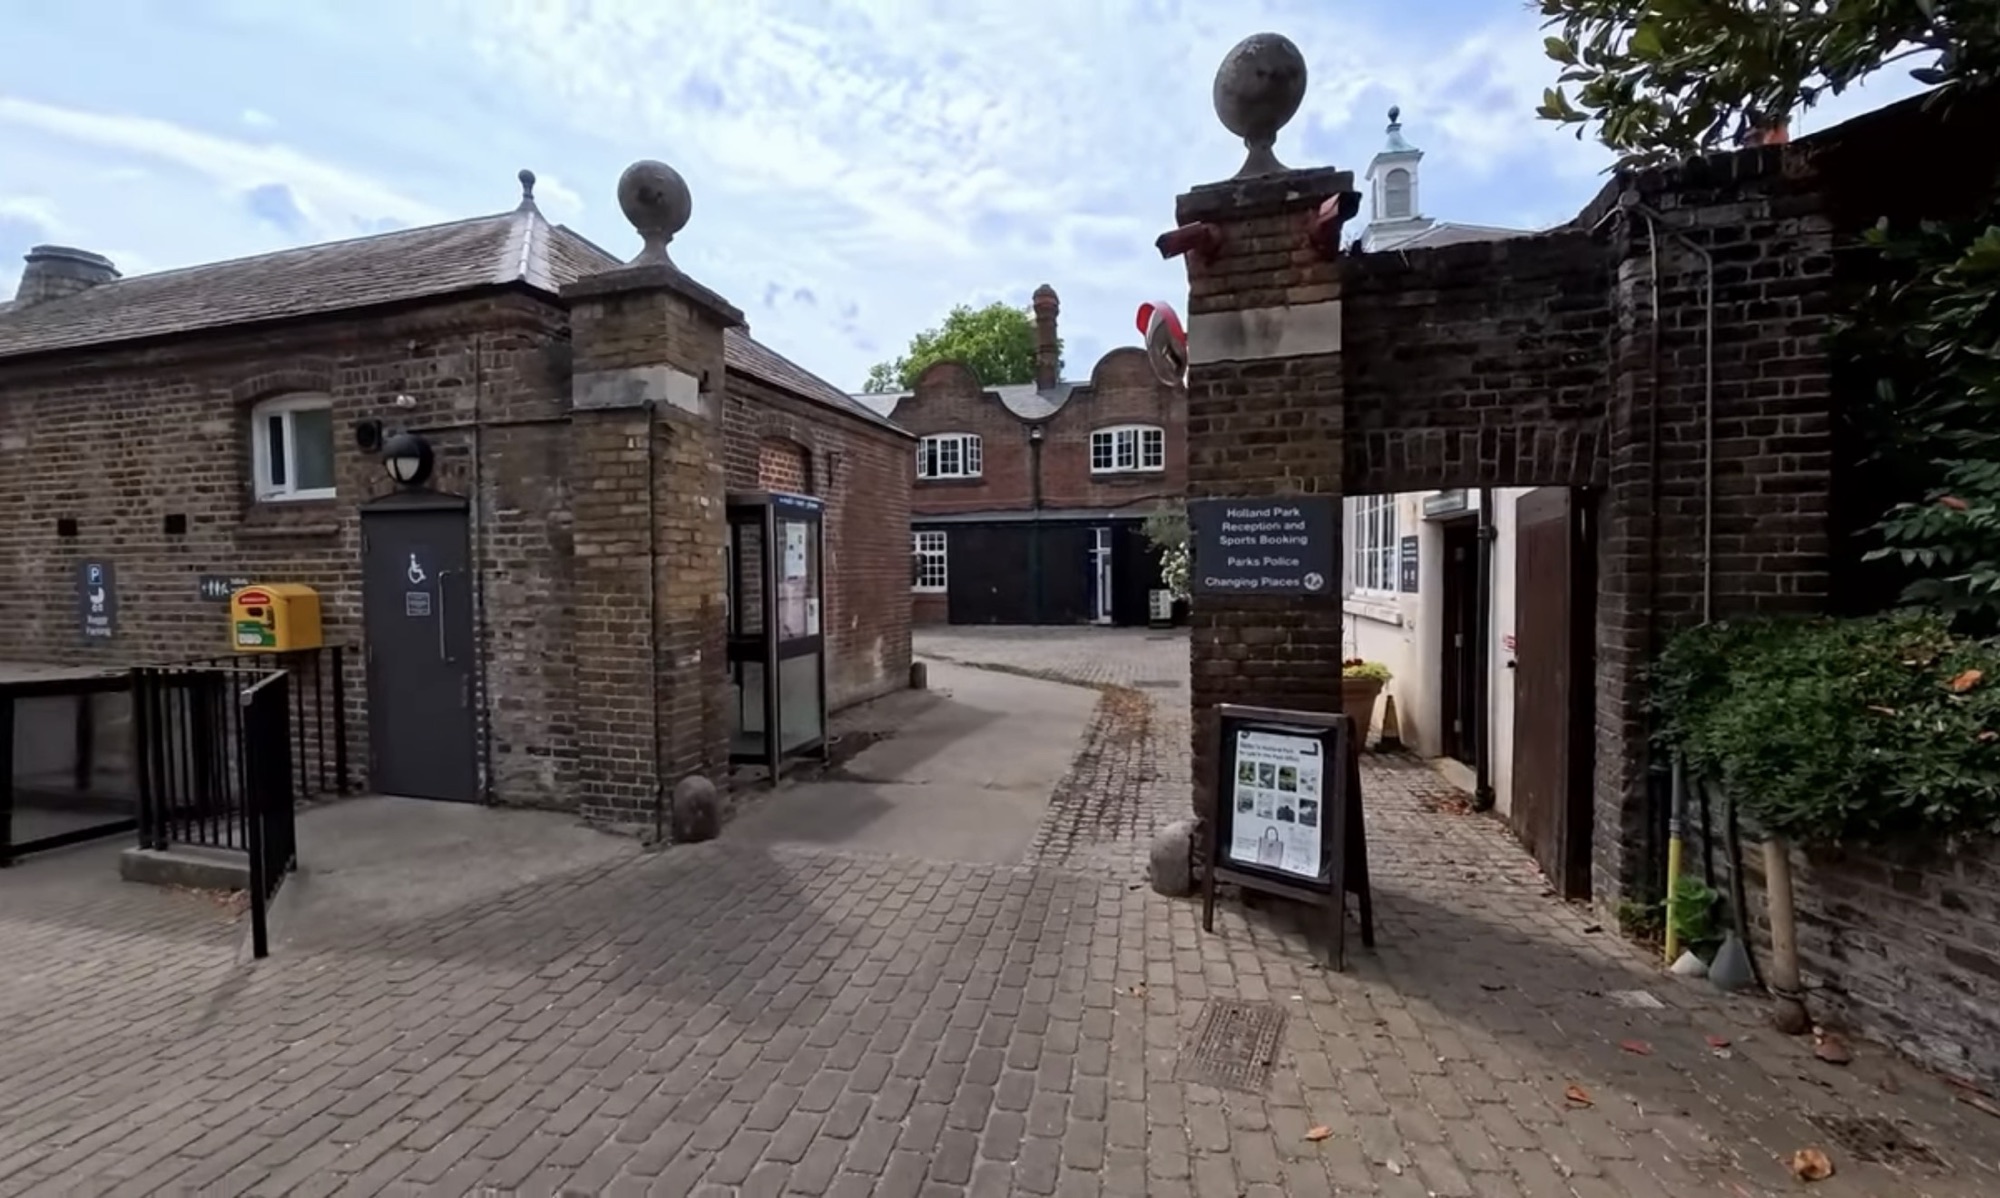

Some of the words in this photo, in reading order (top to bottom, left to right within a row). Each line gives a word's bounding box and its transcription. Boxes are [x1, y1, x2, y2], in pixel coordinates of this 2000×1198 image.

[1226, 508, 1271, 518] Holland
[1273, 507, 1300, 517] Park
[1221, 522, 1281, 532] Reception
[1283, 521, 1306, 530] and
[1219, 535, 1257, 546] Sports
[1259, 535, 1308, 546] Booking
[1227, 557, 1260, 566] Parks
[1263, 557, 1299, 566] Police
[91, 566, 99, 581] P
[1204, 577, 1258, 588] Changing
[1260, 577, 1299, 587] Places
